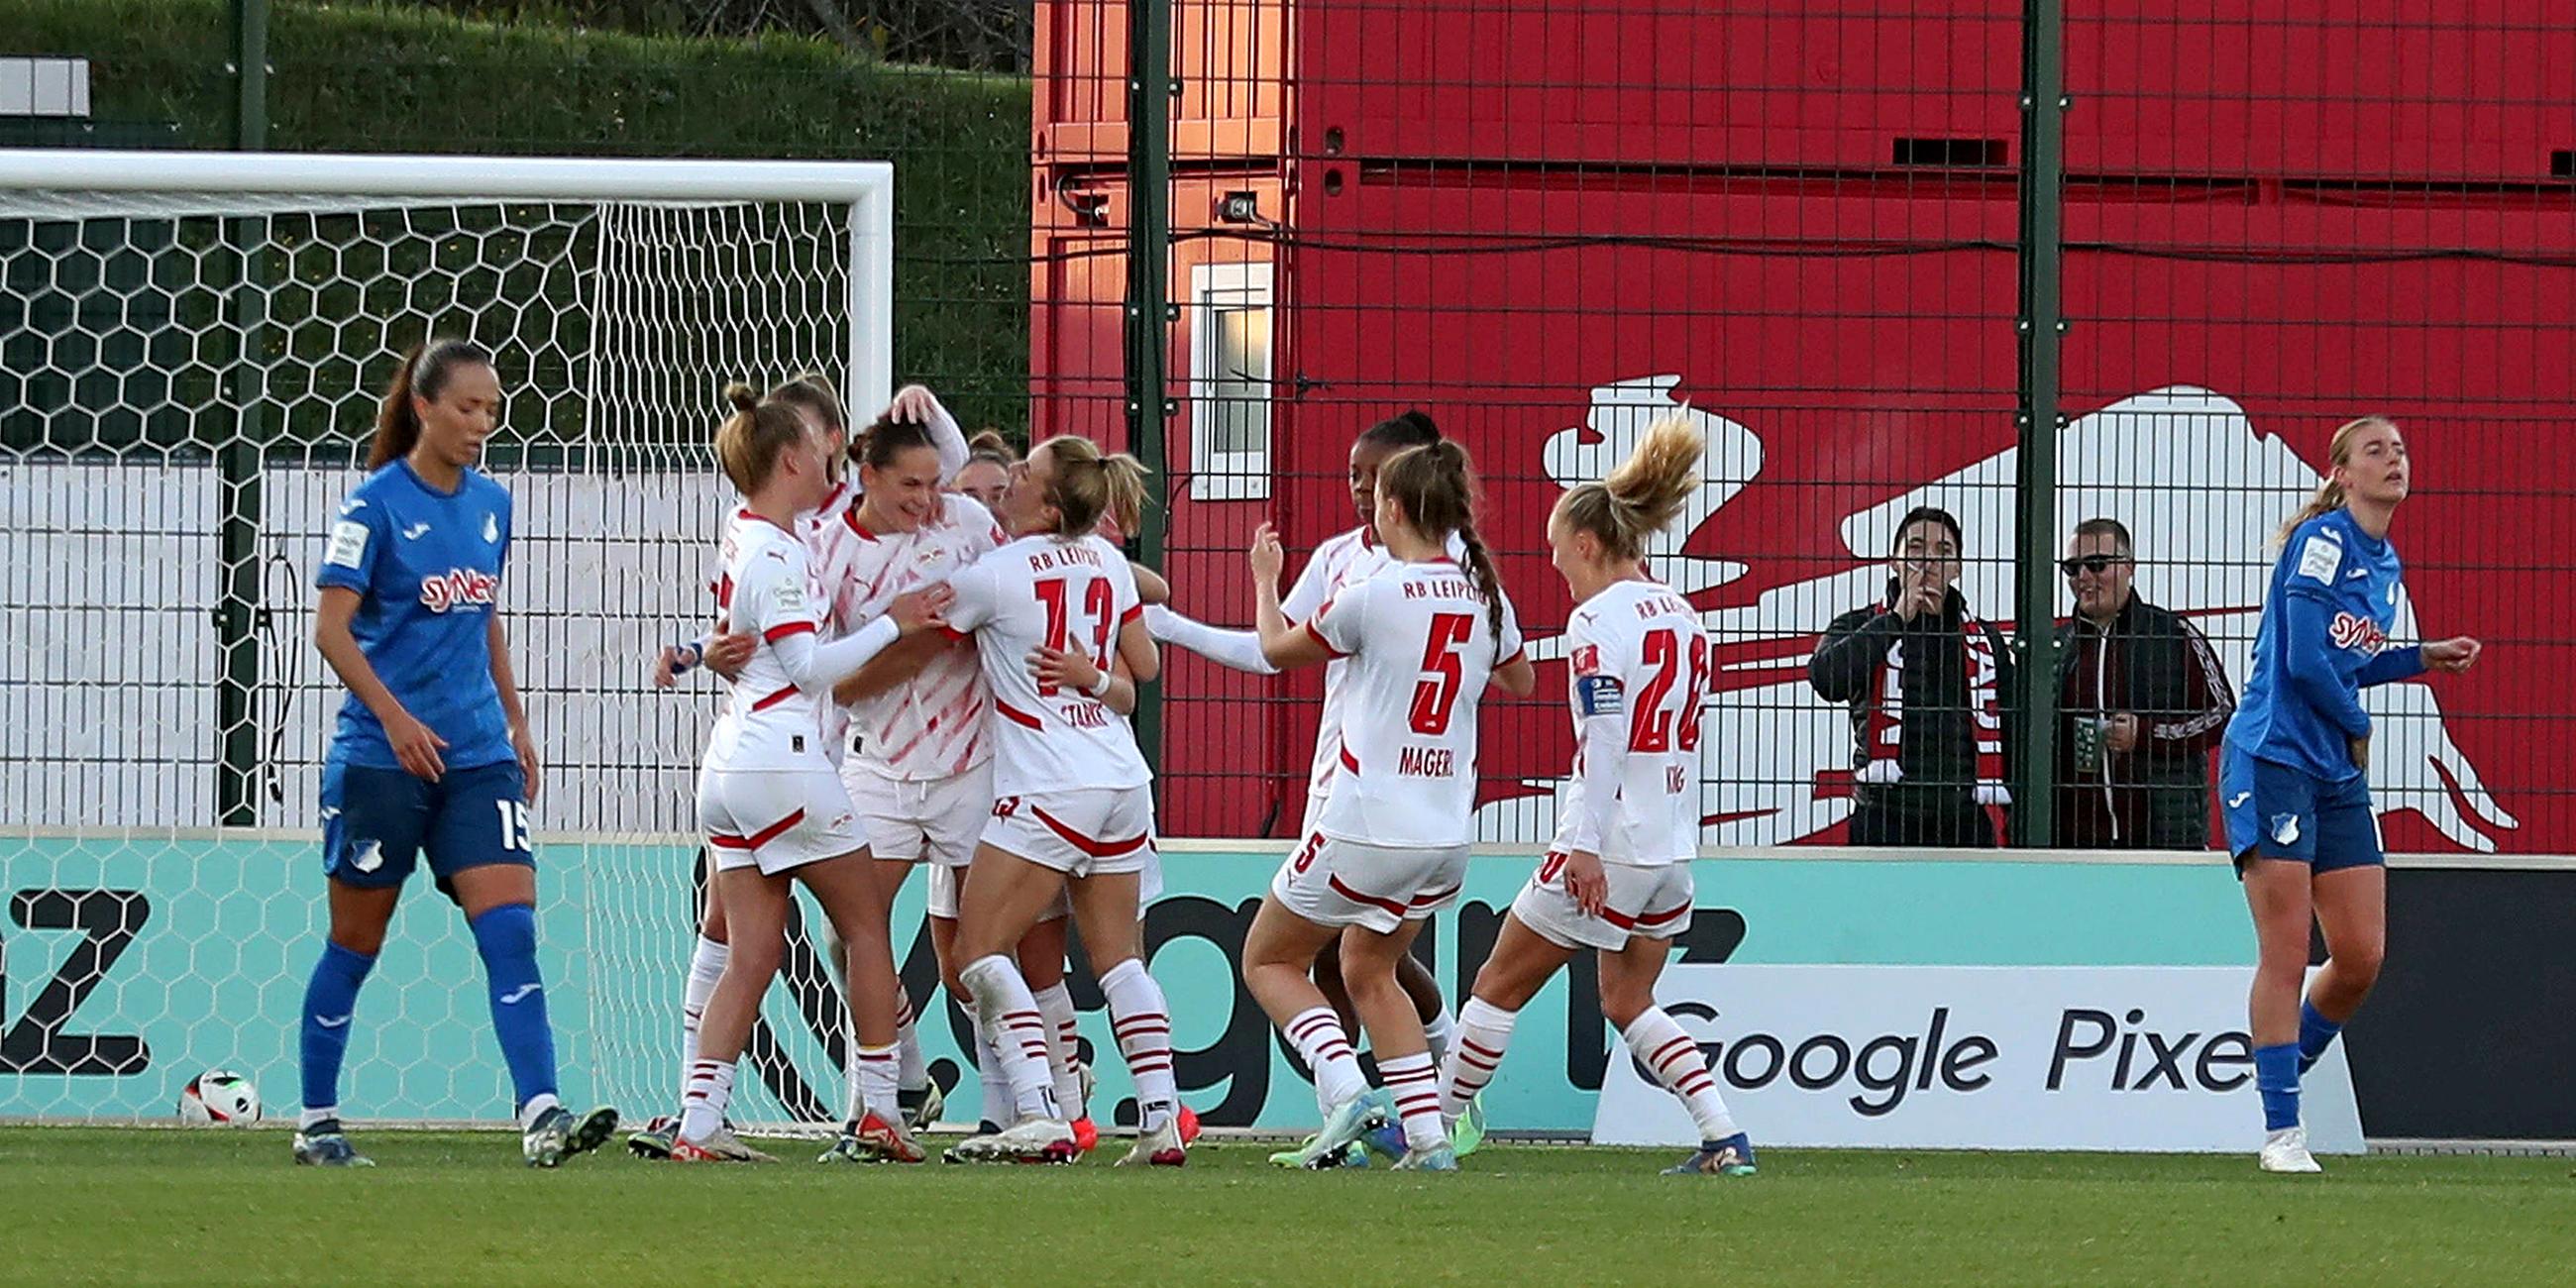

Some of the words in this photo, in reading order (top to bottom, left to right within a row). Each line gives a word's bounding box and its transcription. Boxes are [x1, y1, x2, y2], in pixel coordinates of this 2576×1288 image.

[1028, 552, 1055, 573] RB
[1402, 580, 1428, 599] RB
[1407, 611, 1476, 736] 5
[1294, 830, 1326, 874] 5
[2044, 1008, 2255, 1092] Pixe
